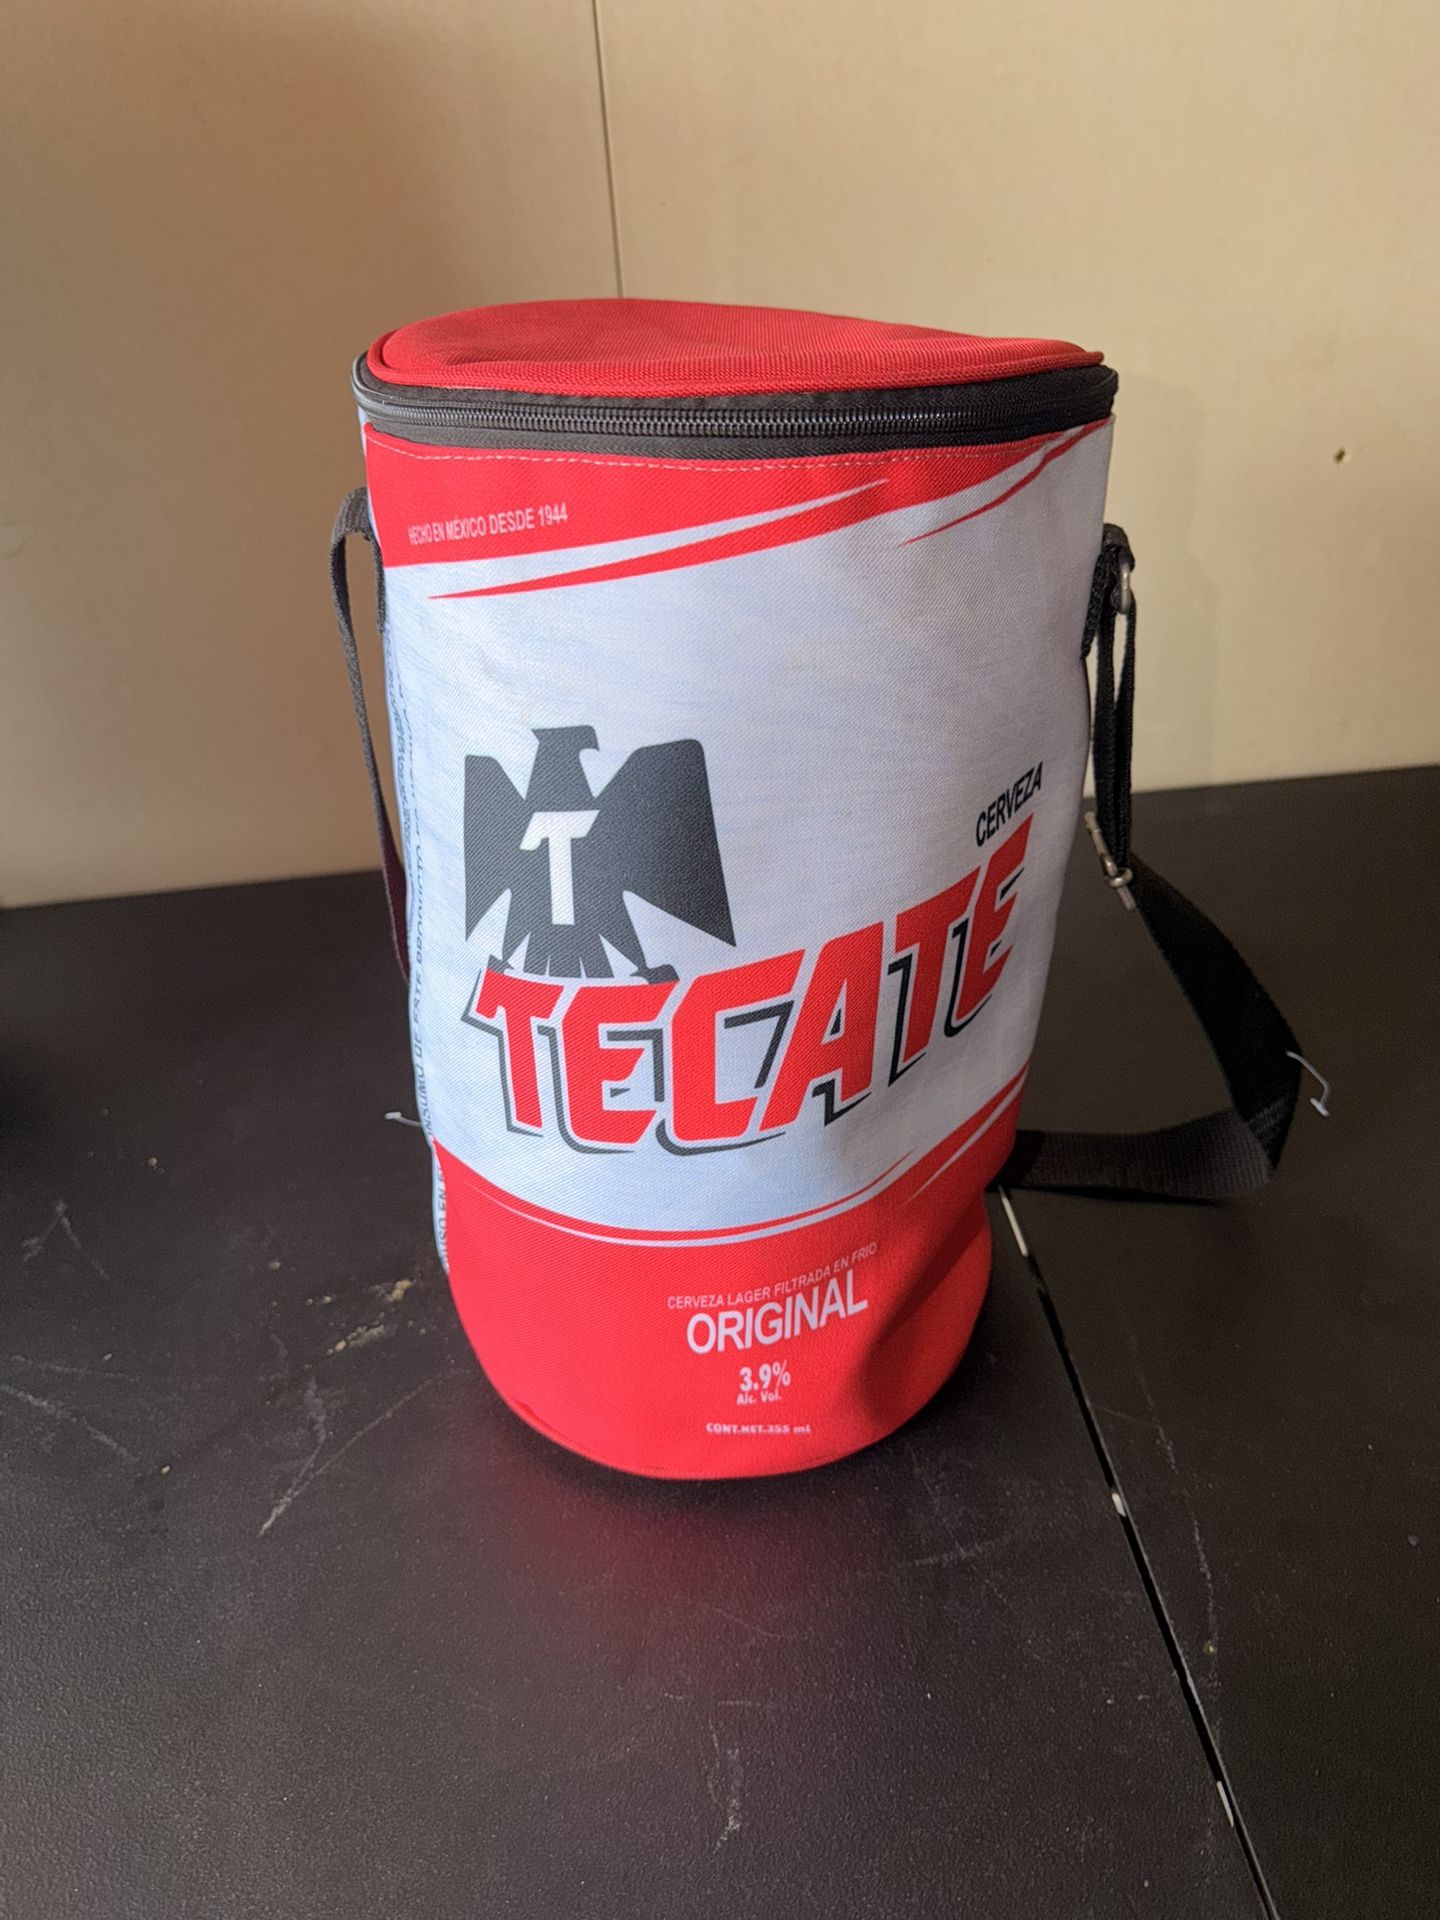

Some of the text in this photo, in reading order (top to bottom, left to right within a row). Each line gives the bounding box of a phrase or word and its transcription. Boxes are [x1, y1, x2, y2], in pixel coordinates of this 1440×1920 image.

[408, 502, 568, 546] HECHO EN MÉXICO DESDE 1944
[976, 762, 1043, 847] CERVEZA
[520, 809, 600, 925] T
[464, 813, 1034, 1154] TECATE
[667, 1295, 724, 1310] CERVEZA
[727, 1286, 771, 1306] LAGER
[773, 1265, 831, 1296] FILTRADA
[833, 1256, 849, 1273] EN
[686, 1268, 869, 1355] ORIGINAL
[736, 1390, 782, 1406] Alc. Vol.
[738, 1359, 792, 1392] 3.9%
